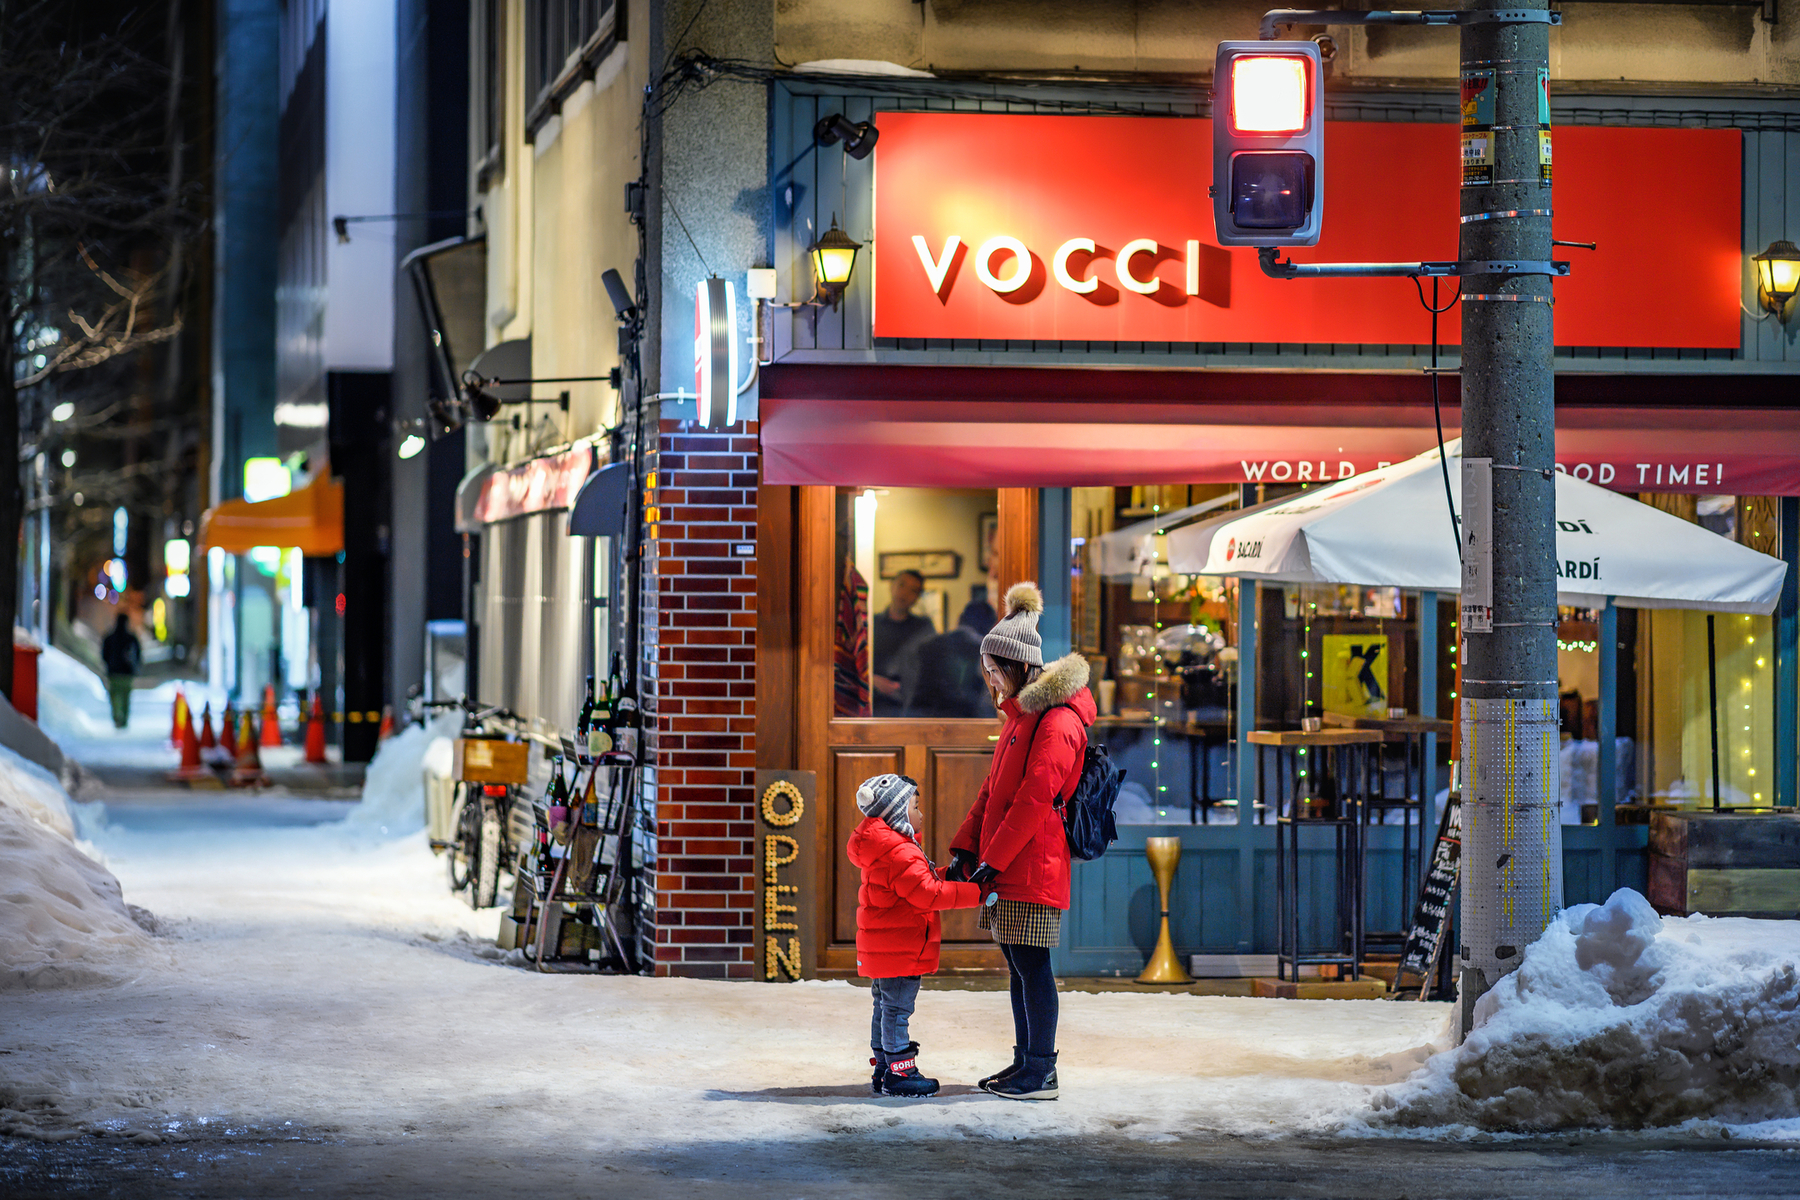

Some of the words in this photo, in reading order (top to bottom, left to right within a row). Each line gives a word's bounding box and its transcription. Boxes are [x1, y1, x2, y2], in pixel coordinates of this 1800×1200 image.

[911, 235, 1200, 295] VOCCI
[1241, 460, 1355, 481] WORLD
[1636, 463, 1723, 485] TIME!
[761, 780, 804, 980] OPEN
